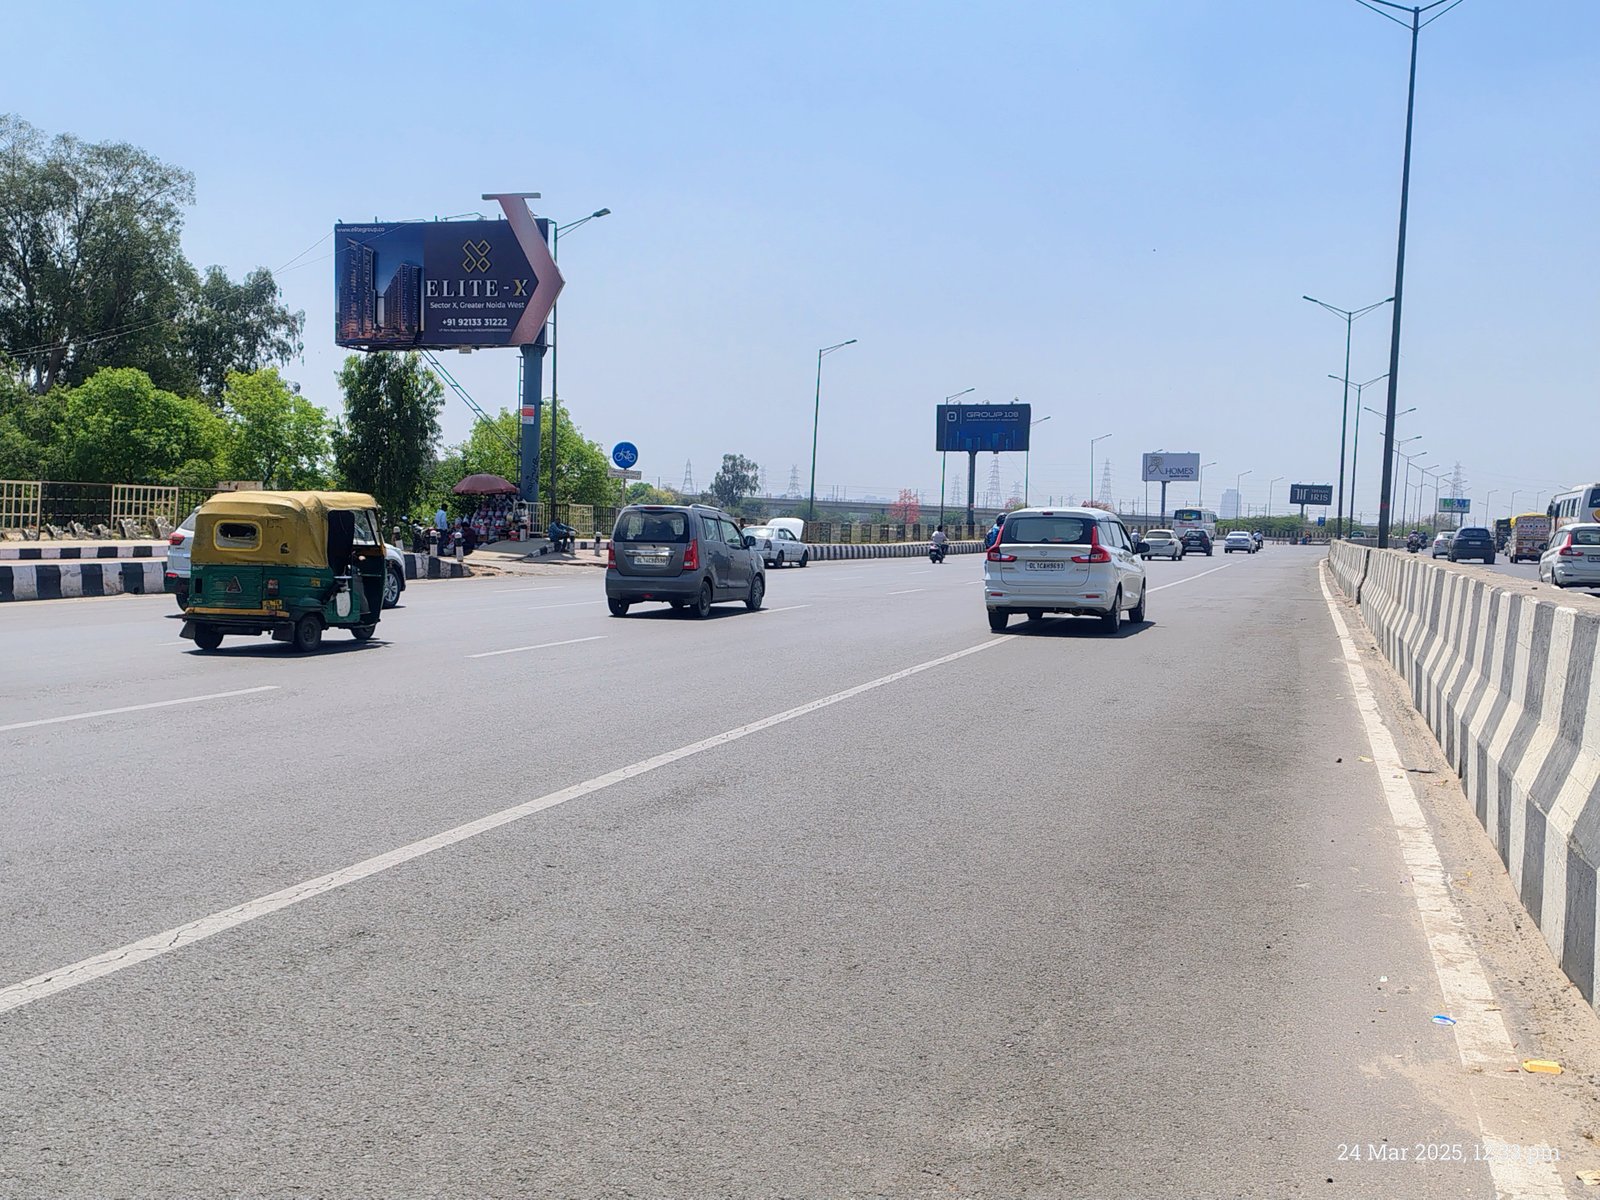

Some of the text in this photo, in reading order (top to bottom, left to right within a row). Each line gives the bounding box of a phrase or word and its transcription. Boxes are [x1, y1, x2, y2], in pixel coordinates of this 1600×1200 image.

[452, 302, 459, 310] X,
[442, 318, 508, 326] +91 92133 31222
[1165, 467, 1194, 475] HOMES
[1310, 493, 1329, 501] IRIS
